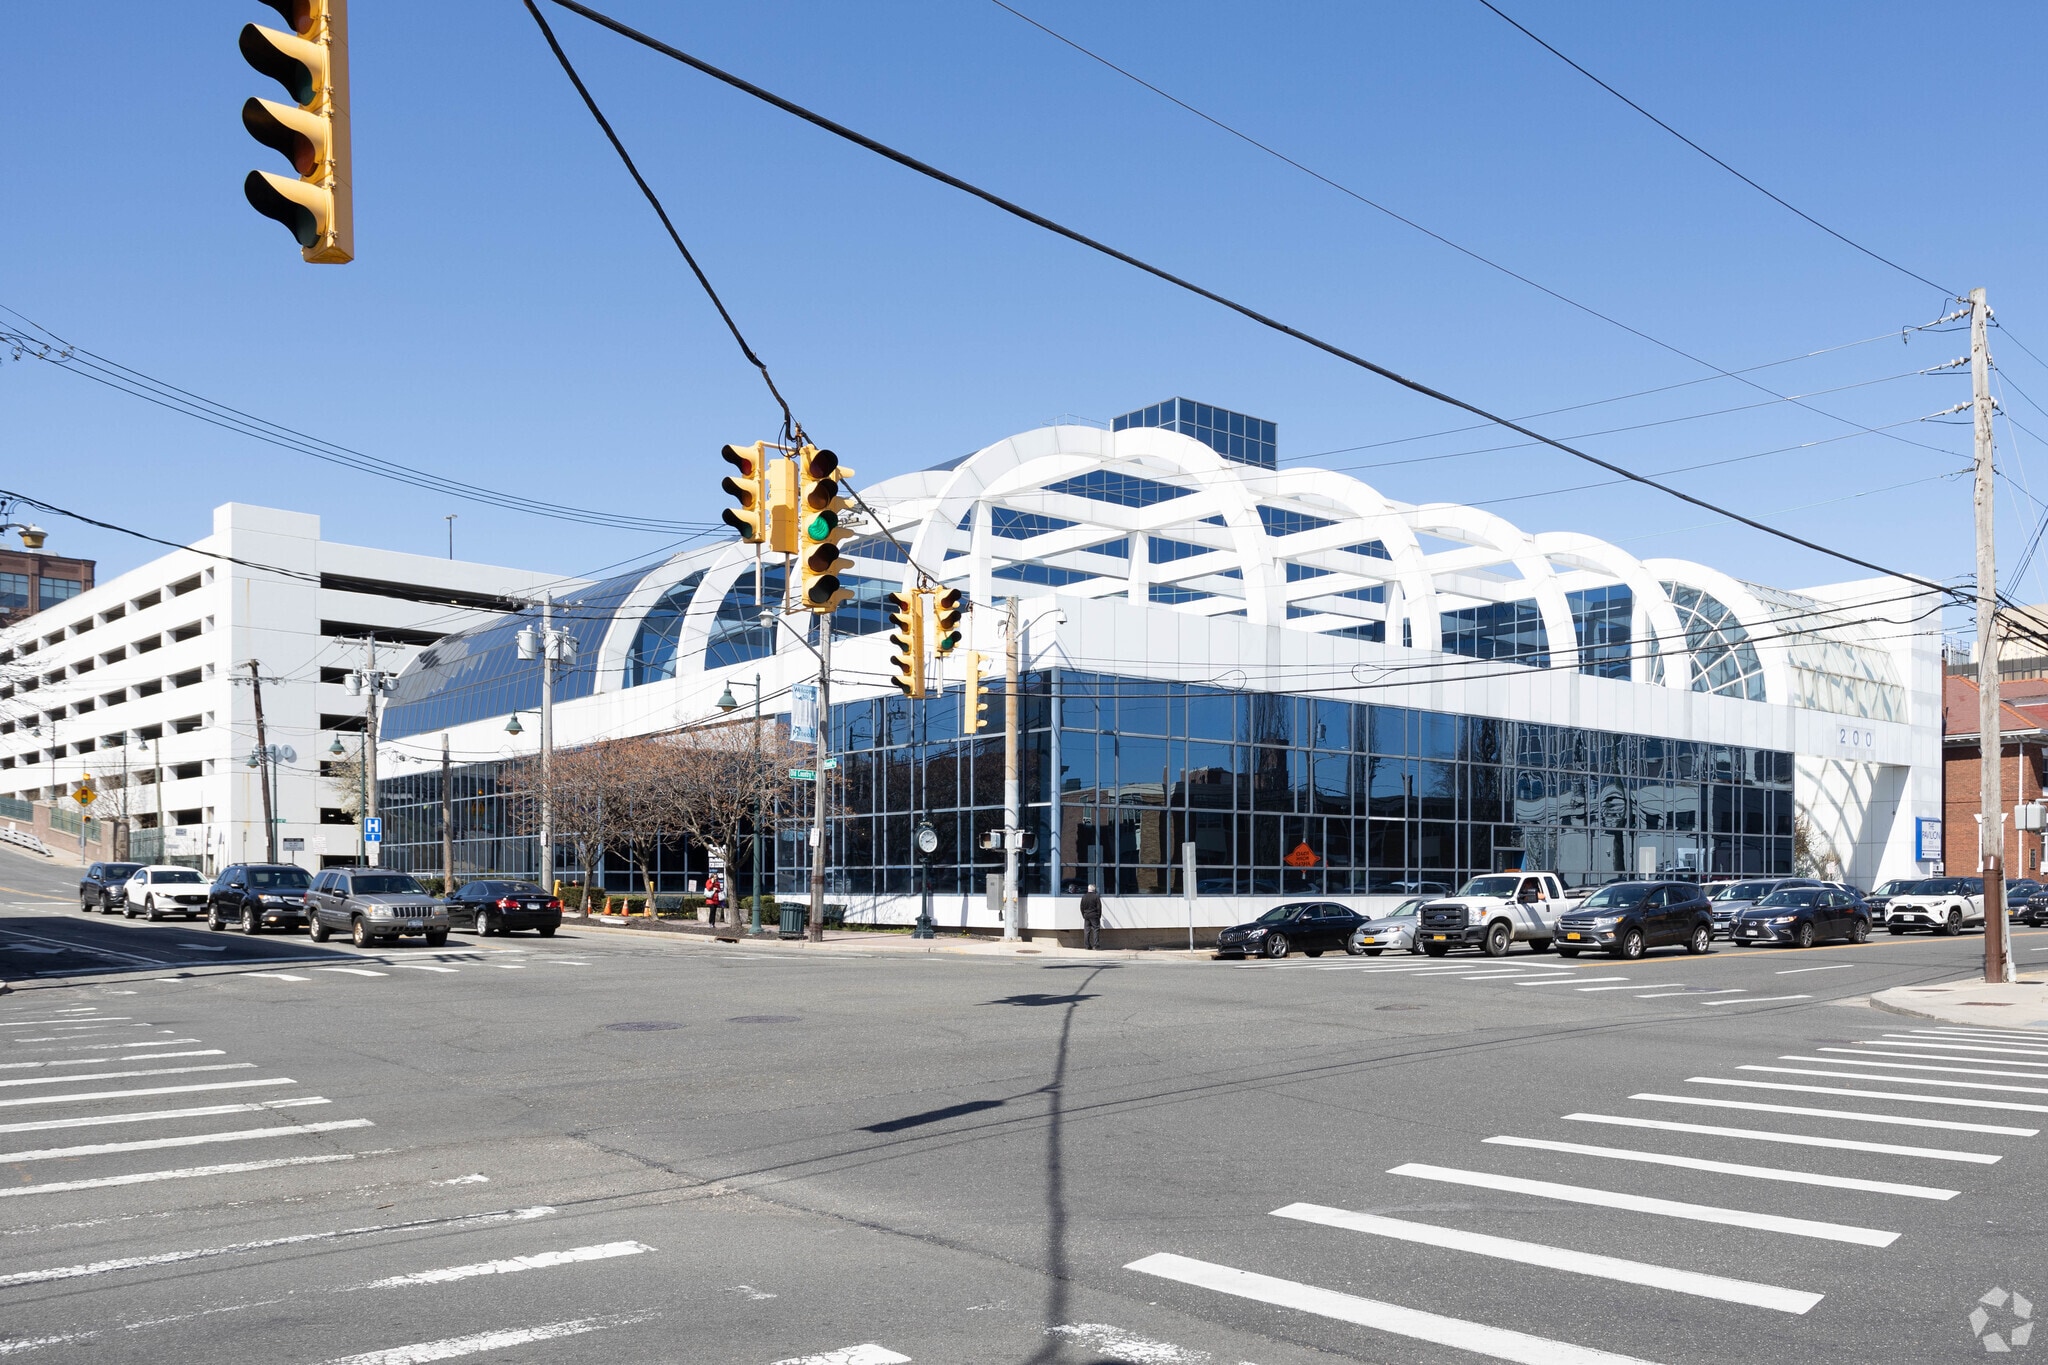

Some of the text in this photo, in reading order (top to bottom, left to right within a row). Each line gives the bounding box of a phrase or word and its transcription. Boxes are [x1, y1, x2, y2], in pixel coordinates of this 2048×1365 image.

[794, 686, 816, 695] Welcome
[1840, 728, 1872, 747] 200
[367, 819, 379, 832] H
